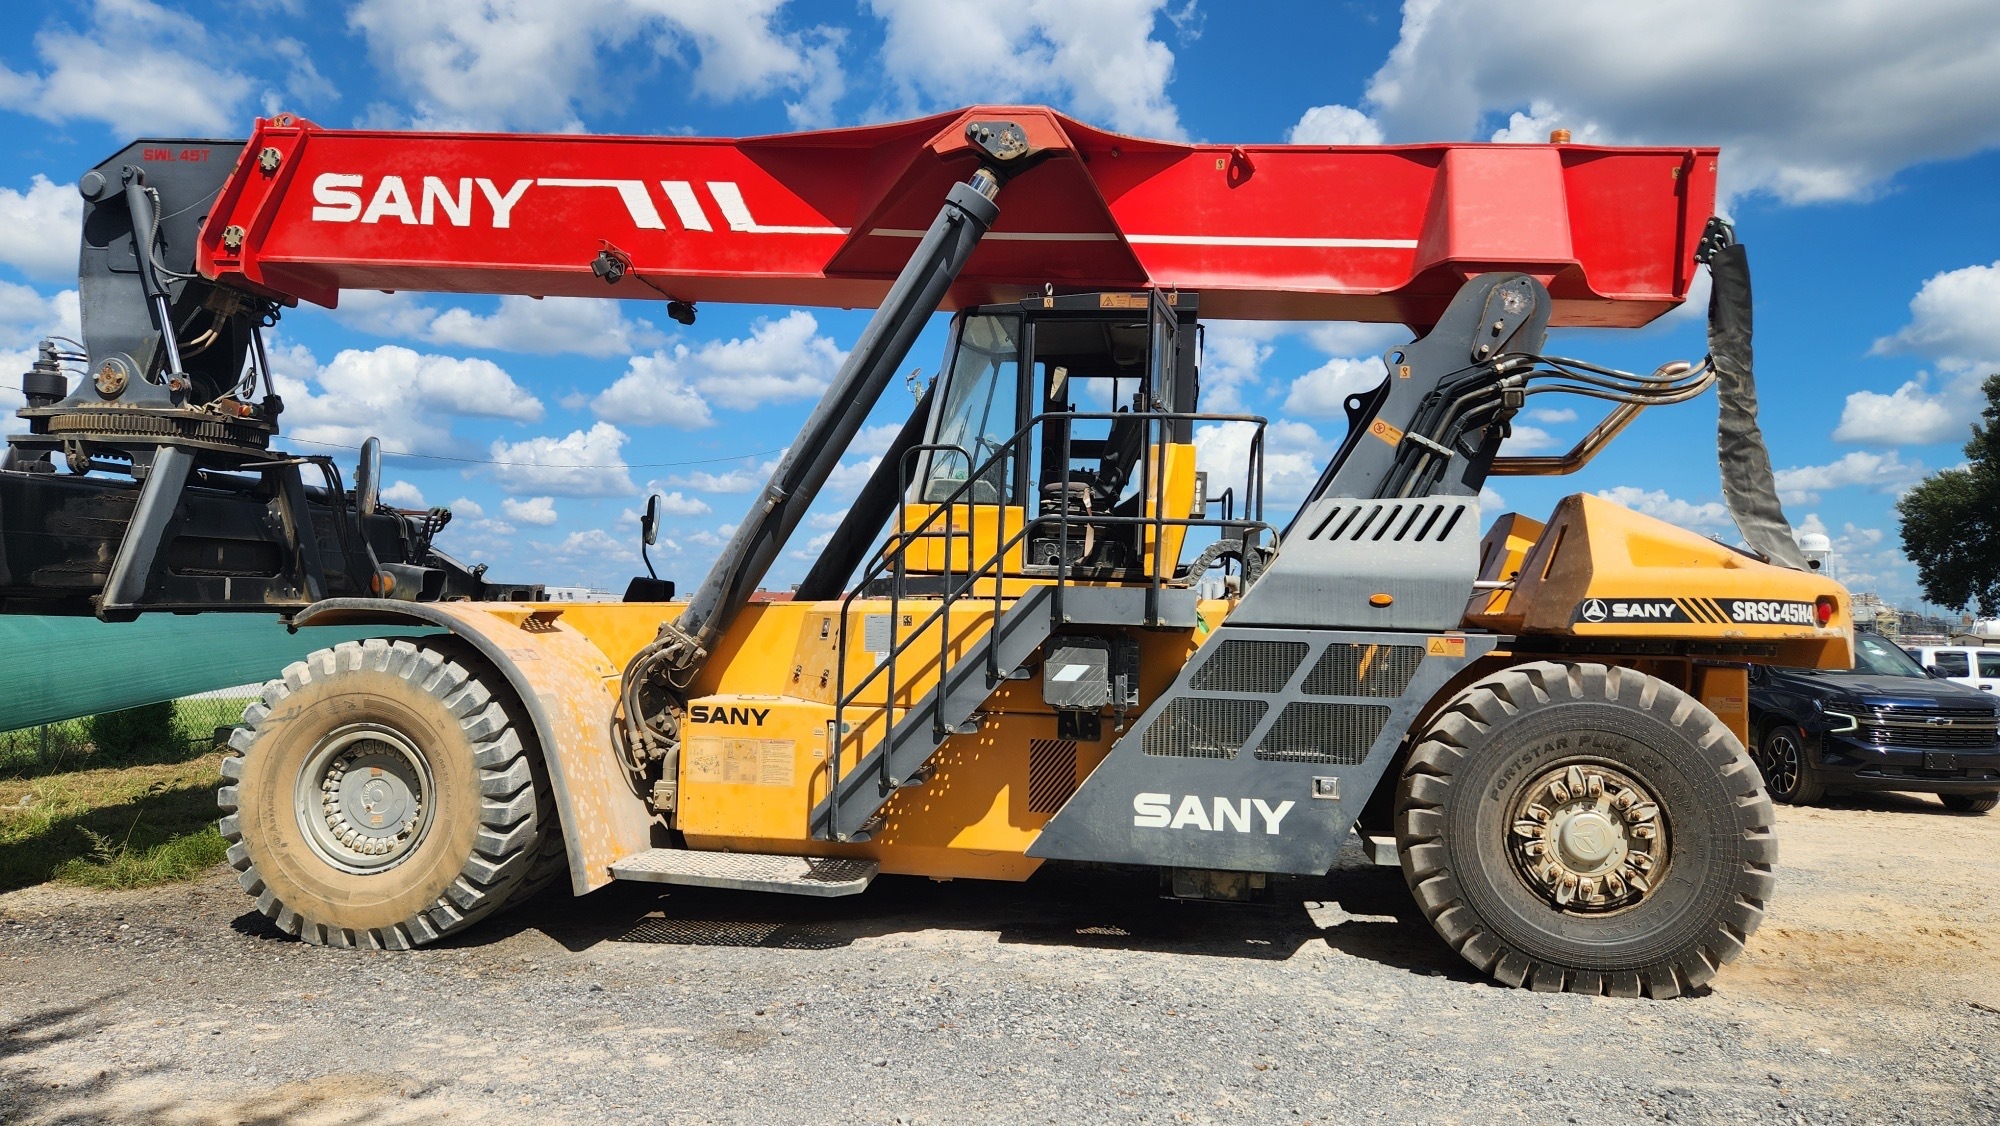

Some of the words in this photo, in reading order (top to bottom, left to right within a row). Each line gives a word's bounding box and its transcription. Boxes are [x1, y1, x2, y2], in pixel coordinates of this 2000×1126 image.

[143, 148, 176, 162] SWL
[179, 148, 211, 162] 45T
[311, 172, 534, 229] SANY
[1612, 602, 1677, 618] SANY
[1732, 600, 1814, 624] SRSC45H4
[690, 705, 771, 726] SANY
[1490, 735, 1569, 802] PORTSTAR
[1577, 735, 1632, 754] PLUS
[1133, 792, 1296, 836] SANY
[1590, 898, 1676, 938] GALAXY
